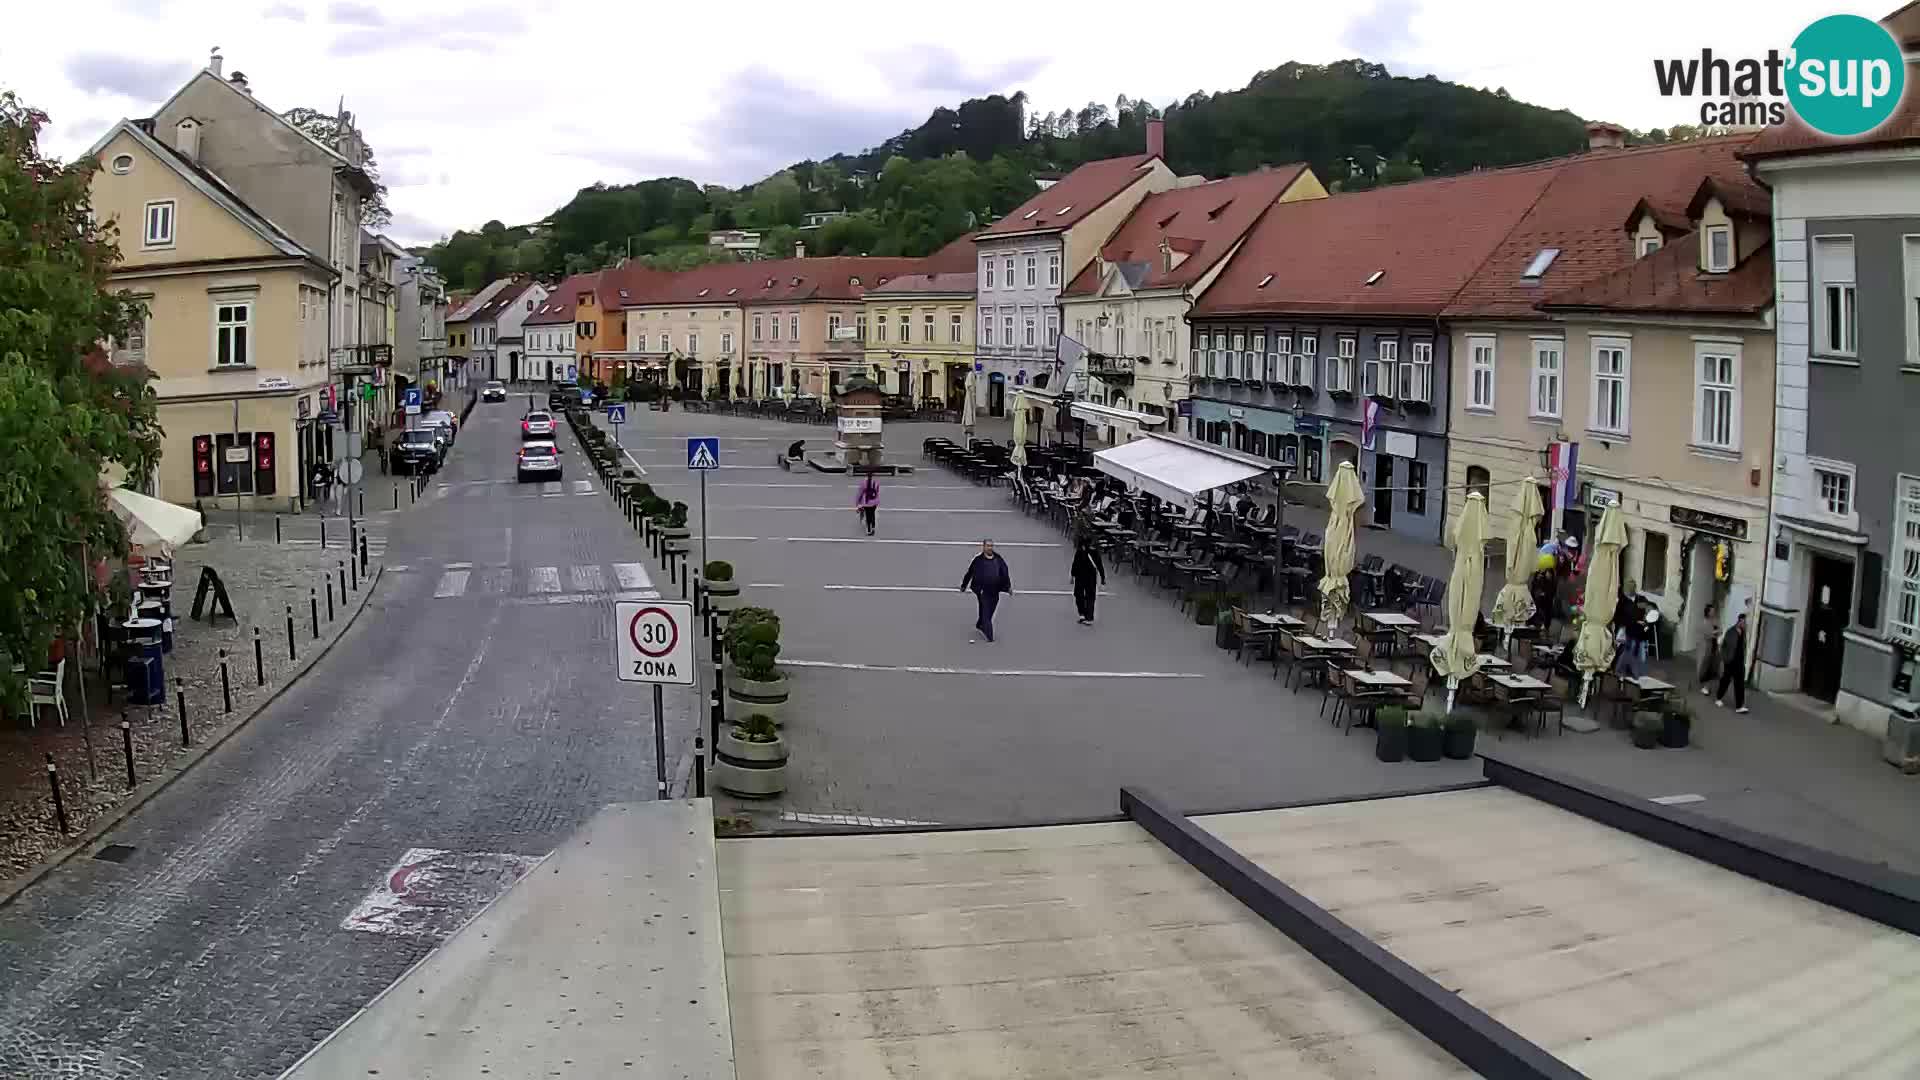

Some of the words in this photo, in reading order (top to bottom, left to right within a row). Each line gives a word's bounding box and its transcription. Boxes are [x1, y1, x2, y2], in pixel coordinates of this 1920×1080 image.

[409, 391, 417, 403] P
[642, 623, 667, 644] 30
[633, 660, 678, 677] ZONA
